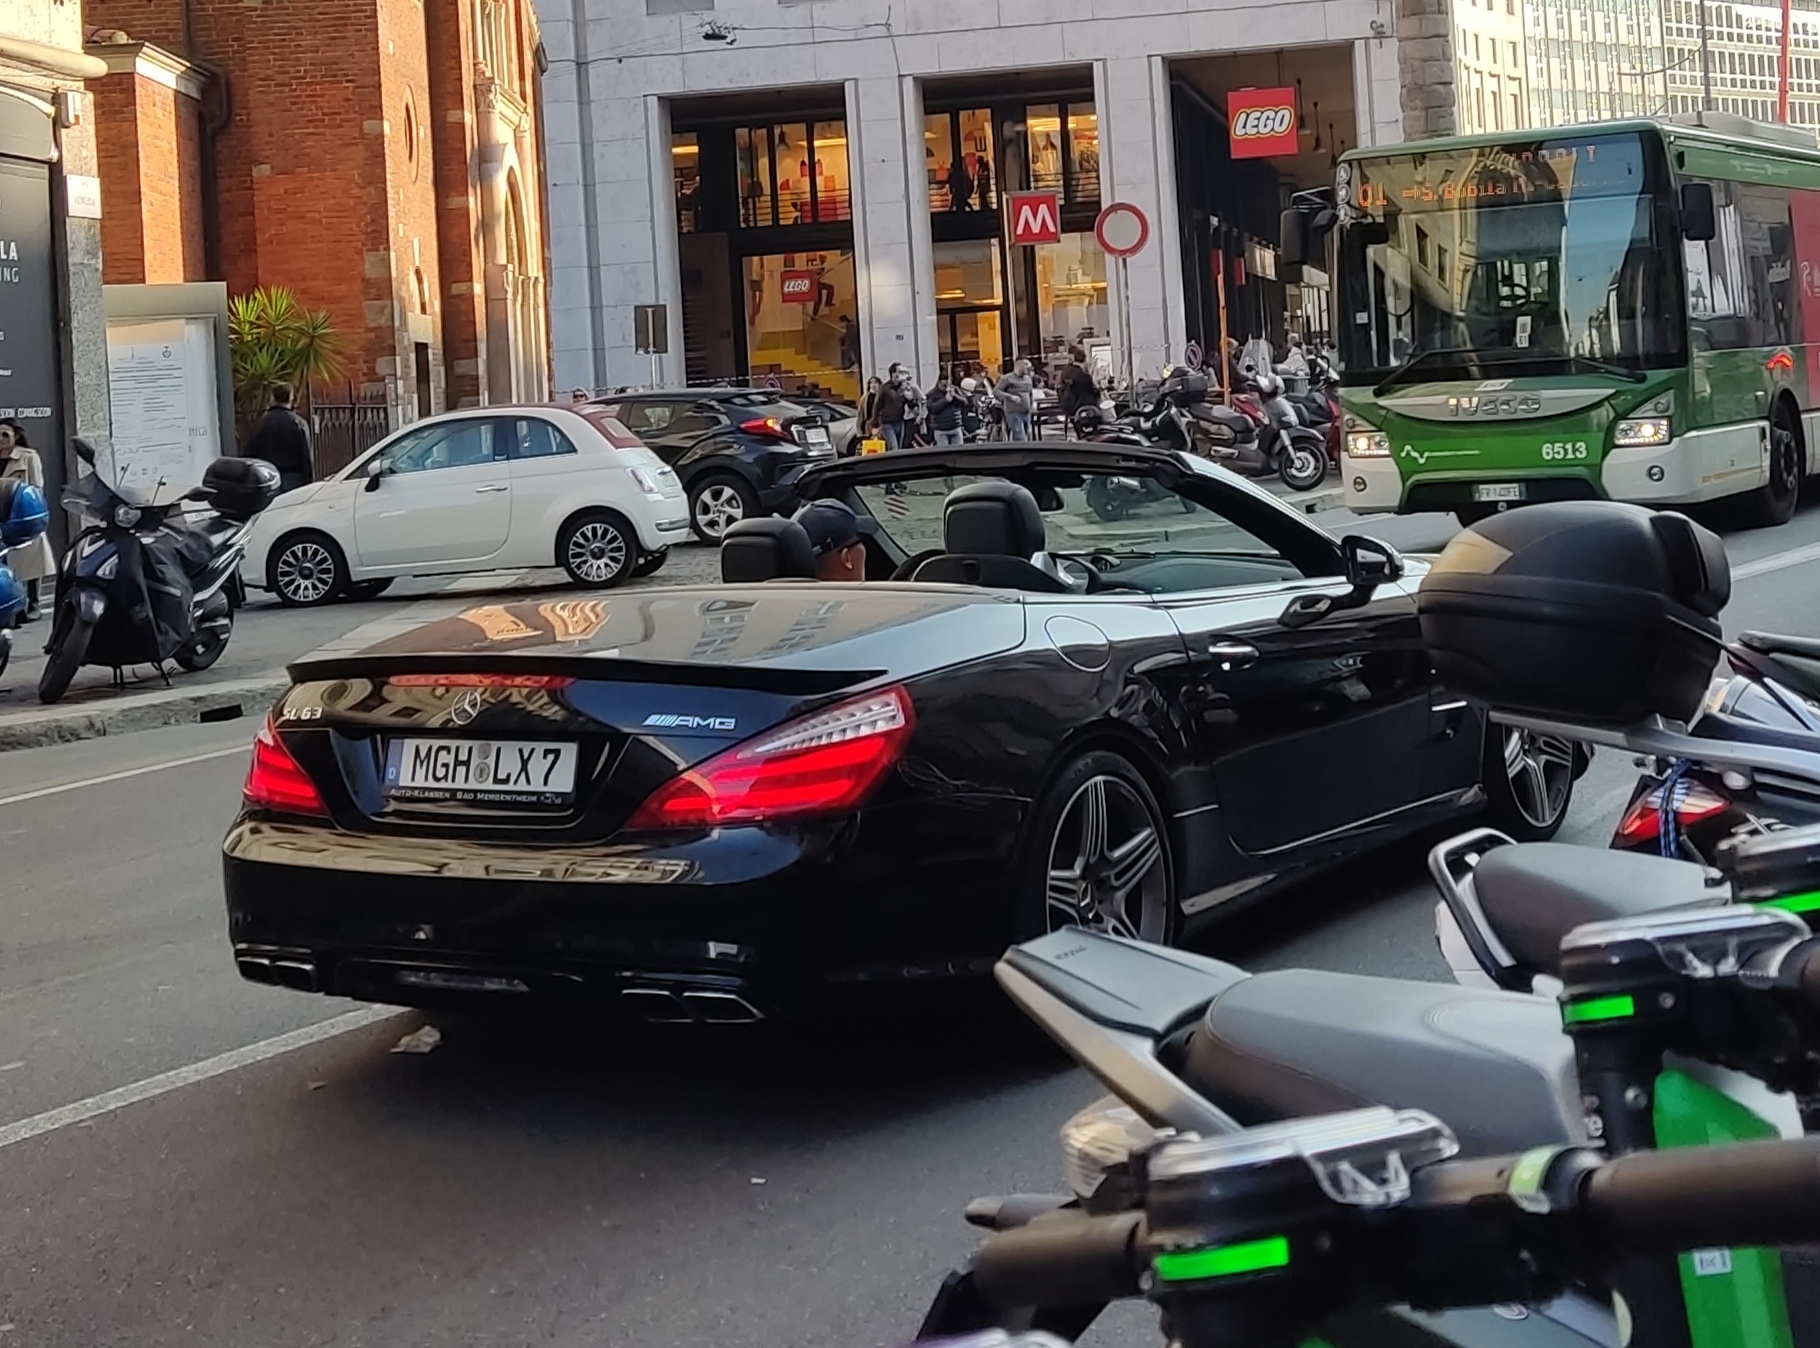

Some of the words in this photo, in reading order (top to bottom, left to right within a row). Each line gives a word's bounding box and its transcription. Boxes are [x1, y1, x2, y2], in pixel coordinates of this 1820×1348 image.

[1233, 107, 1293, 138] LEGO
[1016, 203, 1056, 235] M
[784, 279, 811, 293] LEGO
[1448, 394, 1541, 417] IVECO
[1541, 442, 1587, 461] 6513
[671, 715, 736, 730] AMG
[411, 744, 474, 784] MGH
